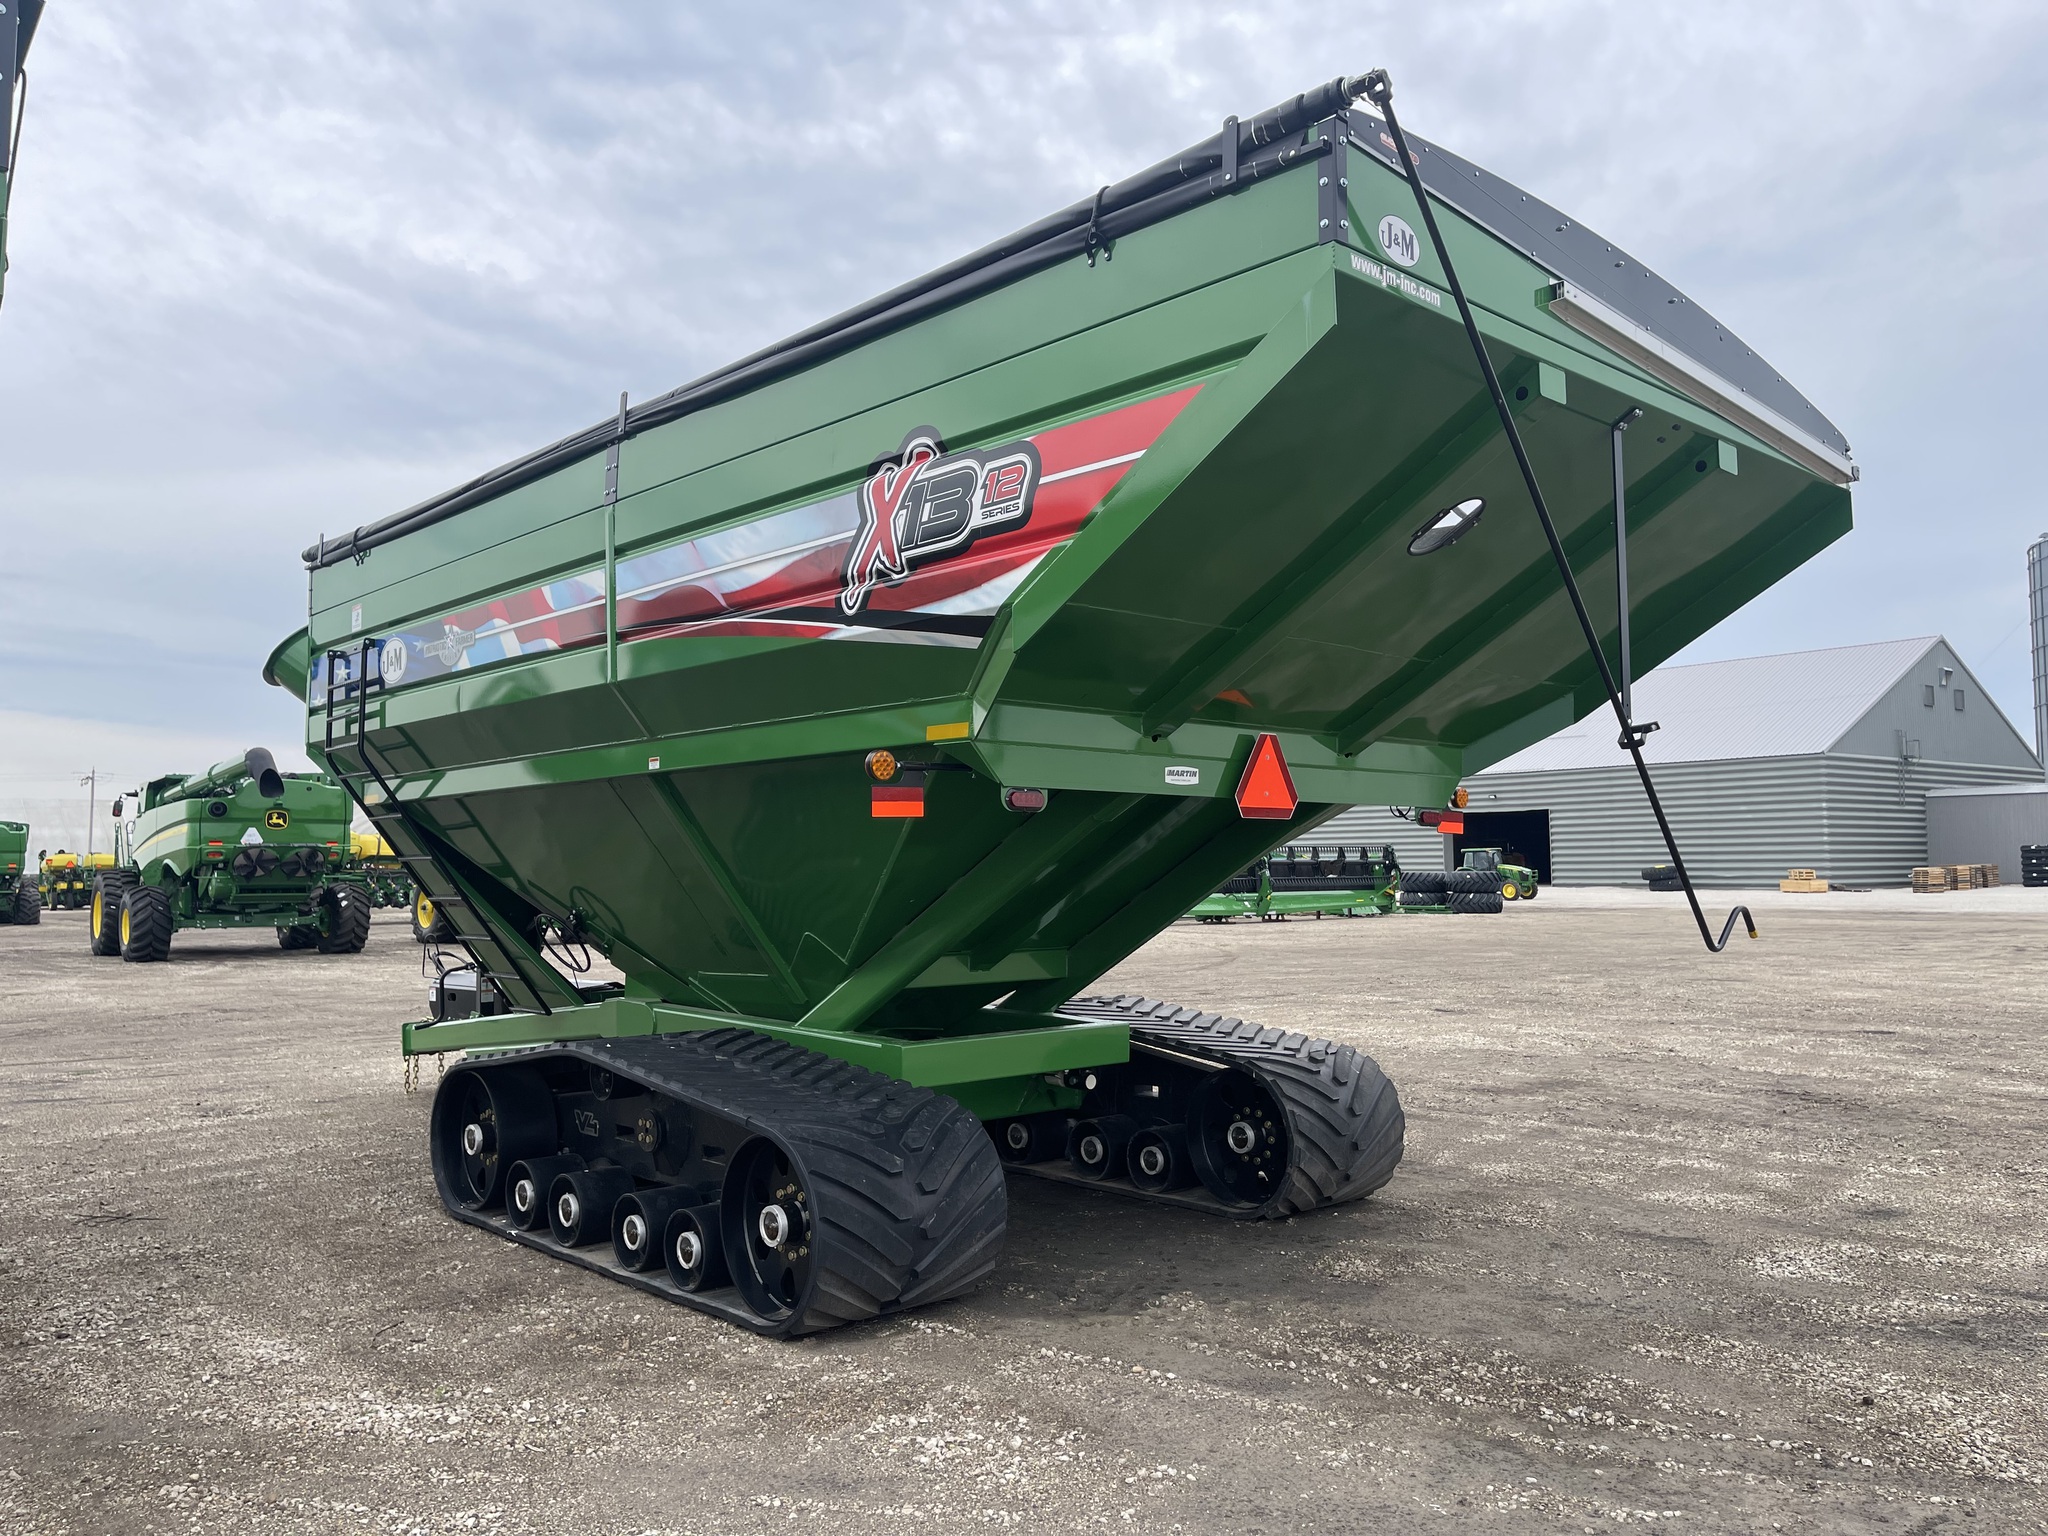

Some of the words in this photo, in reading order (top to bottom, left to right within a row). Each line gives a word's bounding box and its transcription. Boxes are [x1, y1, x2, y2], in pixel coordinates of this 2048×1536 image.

[1381, 221, 1415, 262] J&M
[1351, 253, 1441, 308] www.jm-inc.com
[984, 465, 1024, 504] 12
[981, 502, 1020, 520] SERIES
[383, 647, 402, 674] J&M
[1166, 769, 1198, 777] MARTIN
